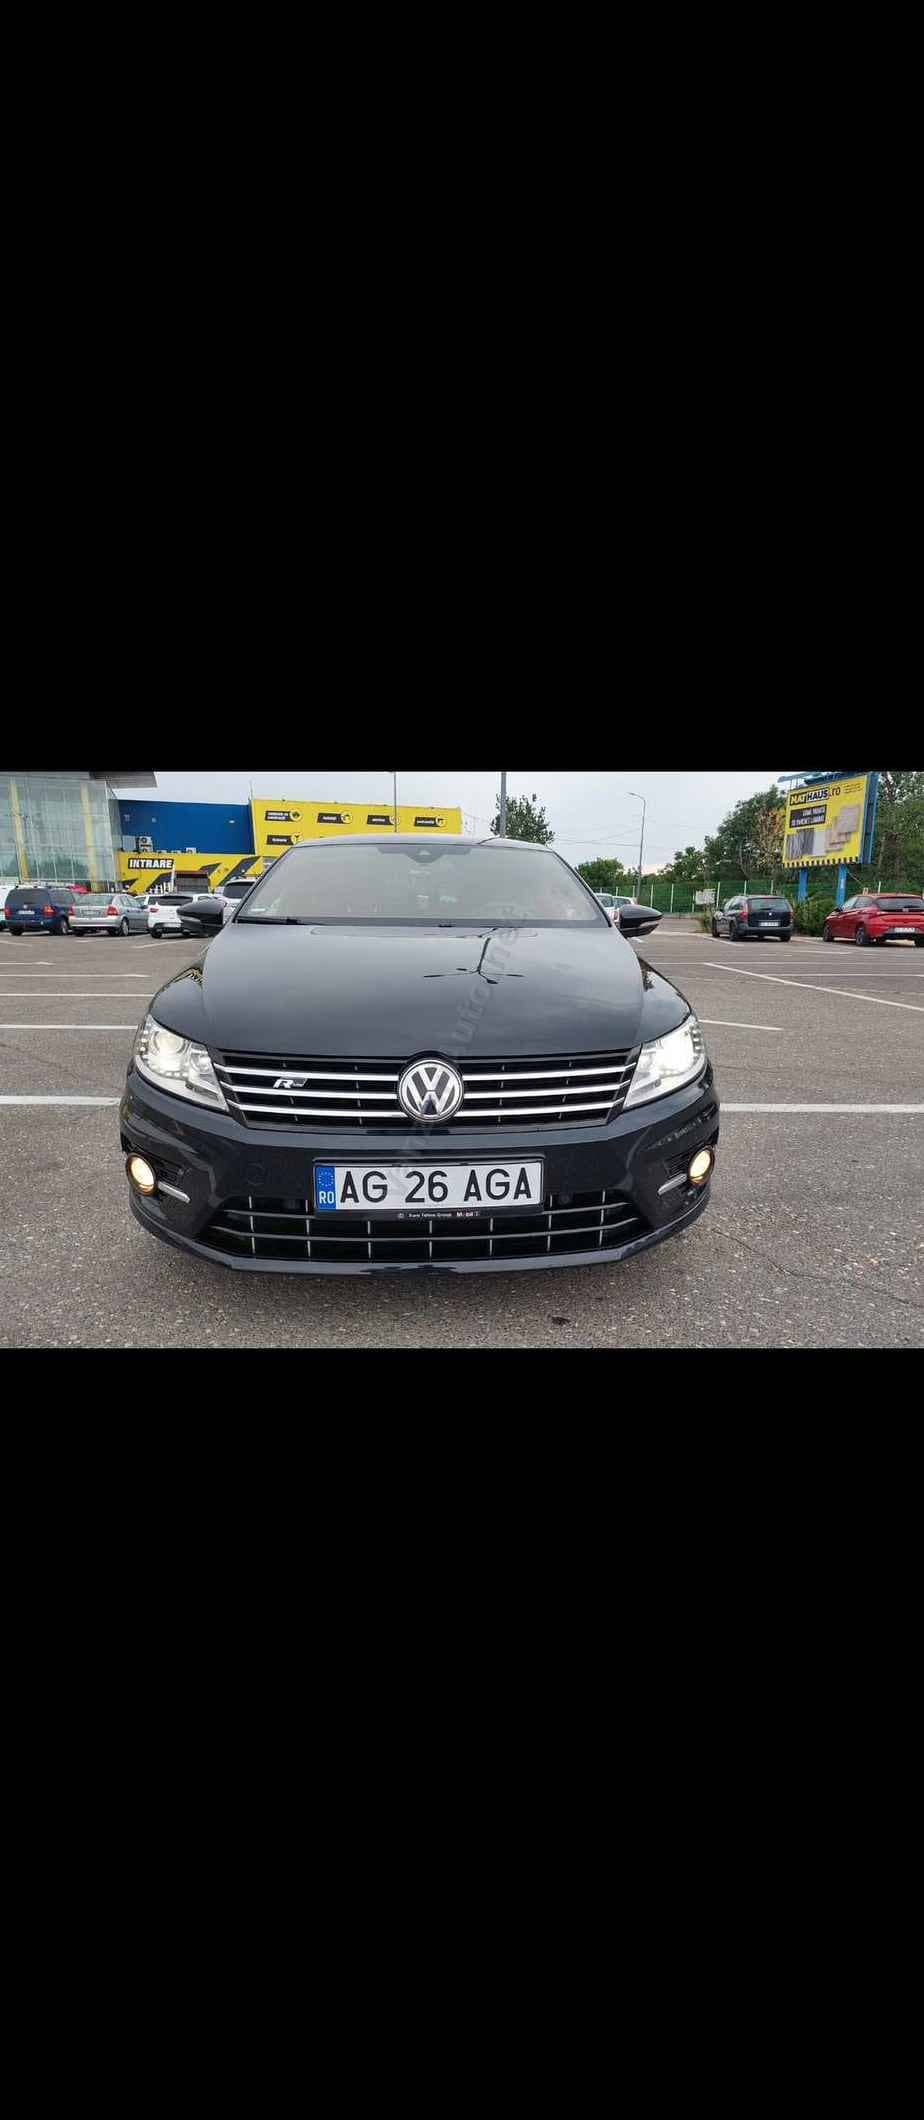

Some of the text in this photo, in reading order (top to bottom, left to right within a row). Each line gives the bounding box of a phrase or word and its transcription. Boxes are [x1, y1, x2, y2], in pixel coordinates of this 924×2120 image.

[129, 858, 173, 869] INTRARE
[340, 1167, 532, 1203] AG 26 AGA
[319, 1191, 336, 1205] RO
